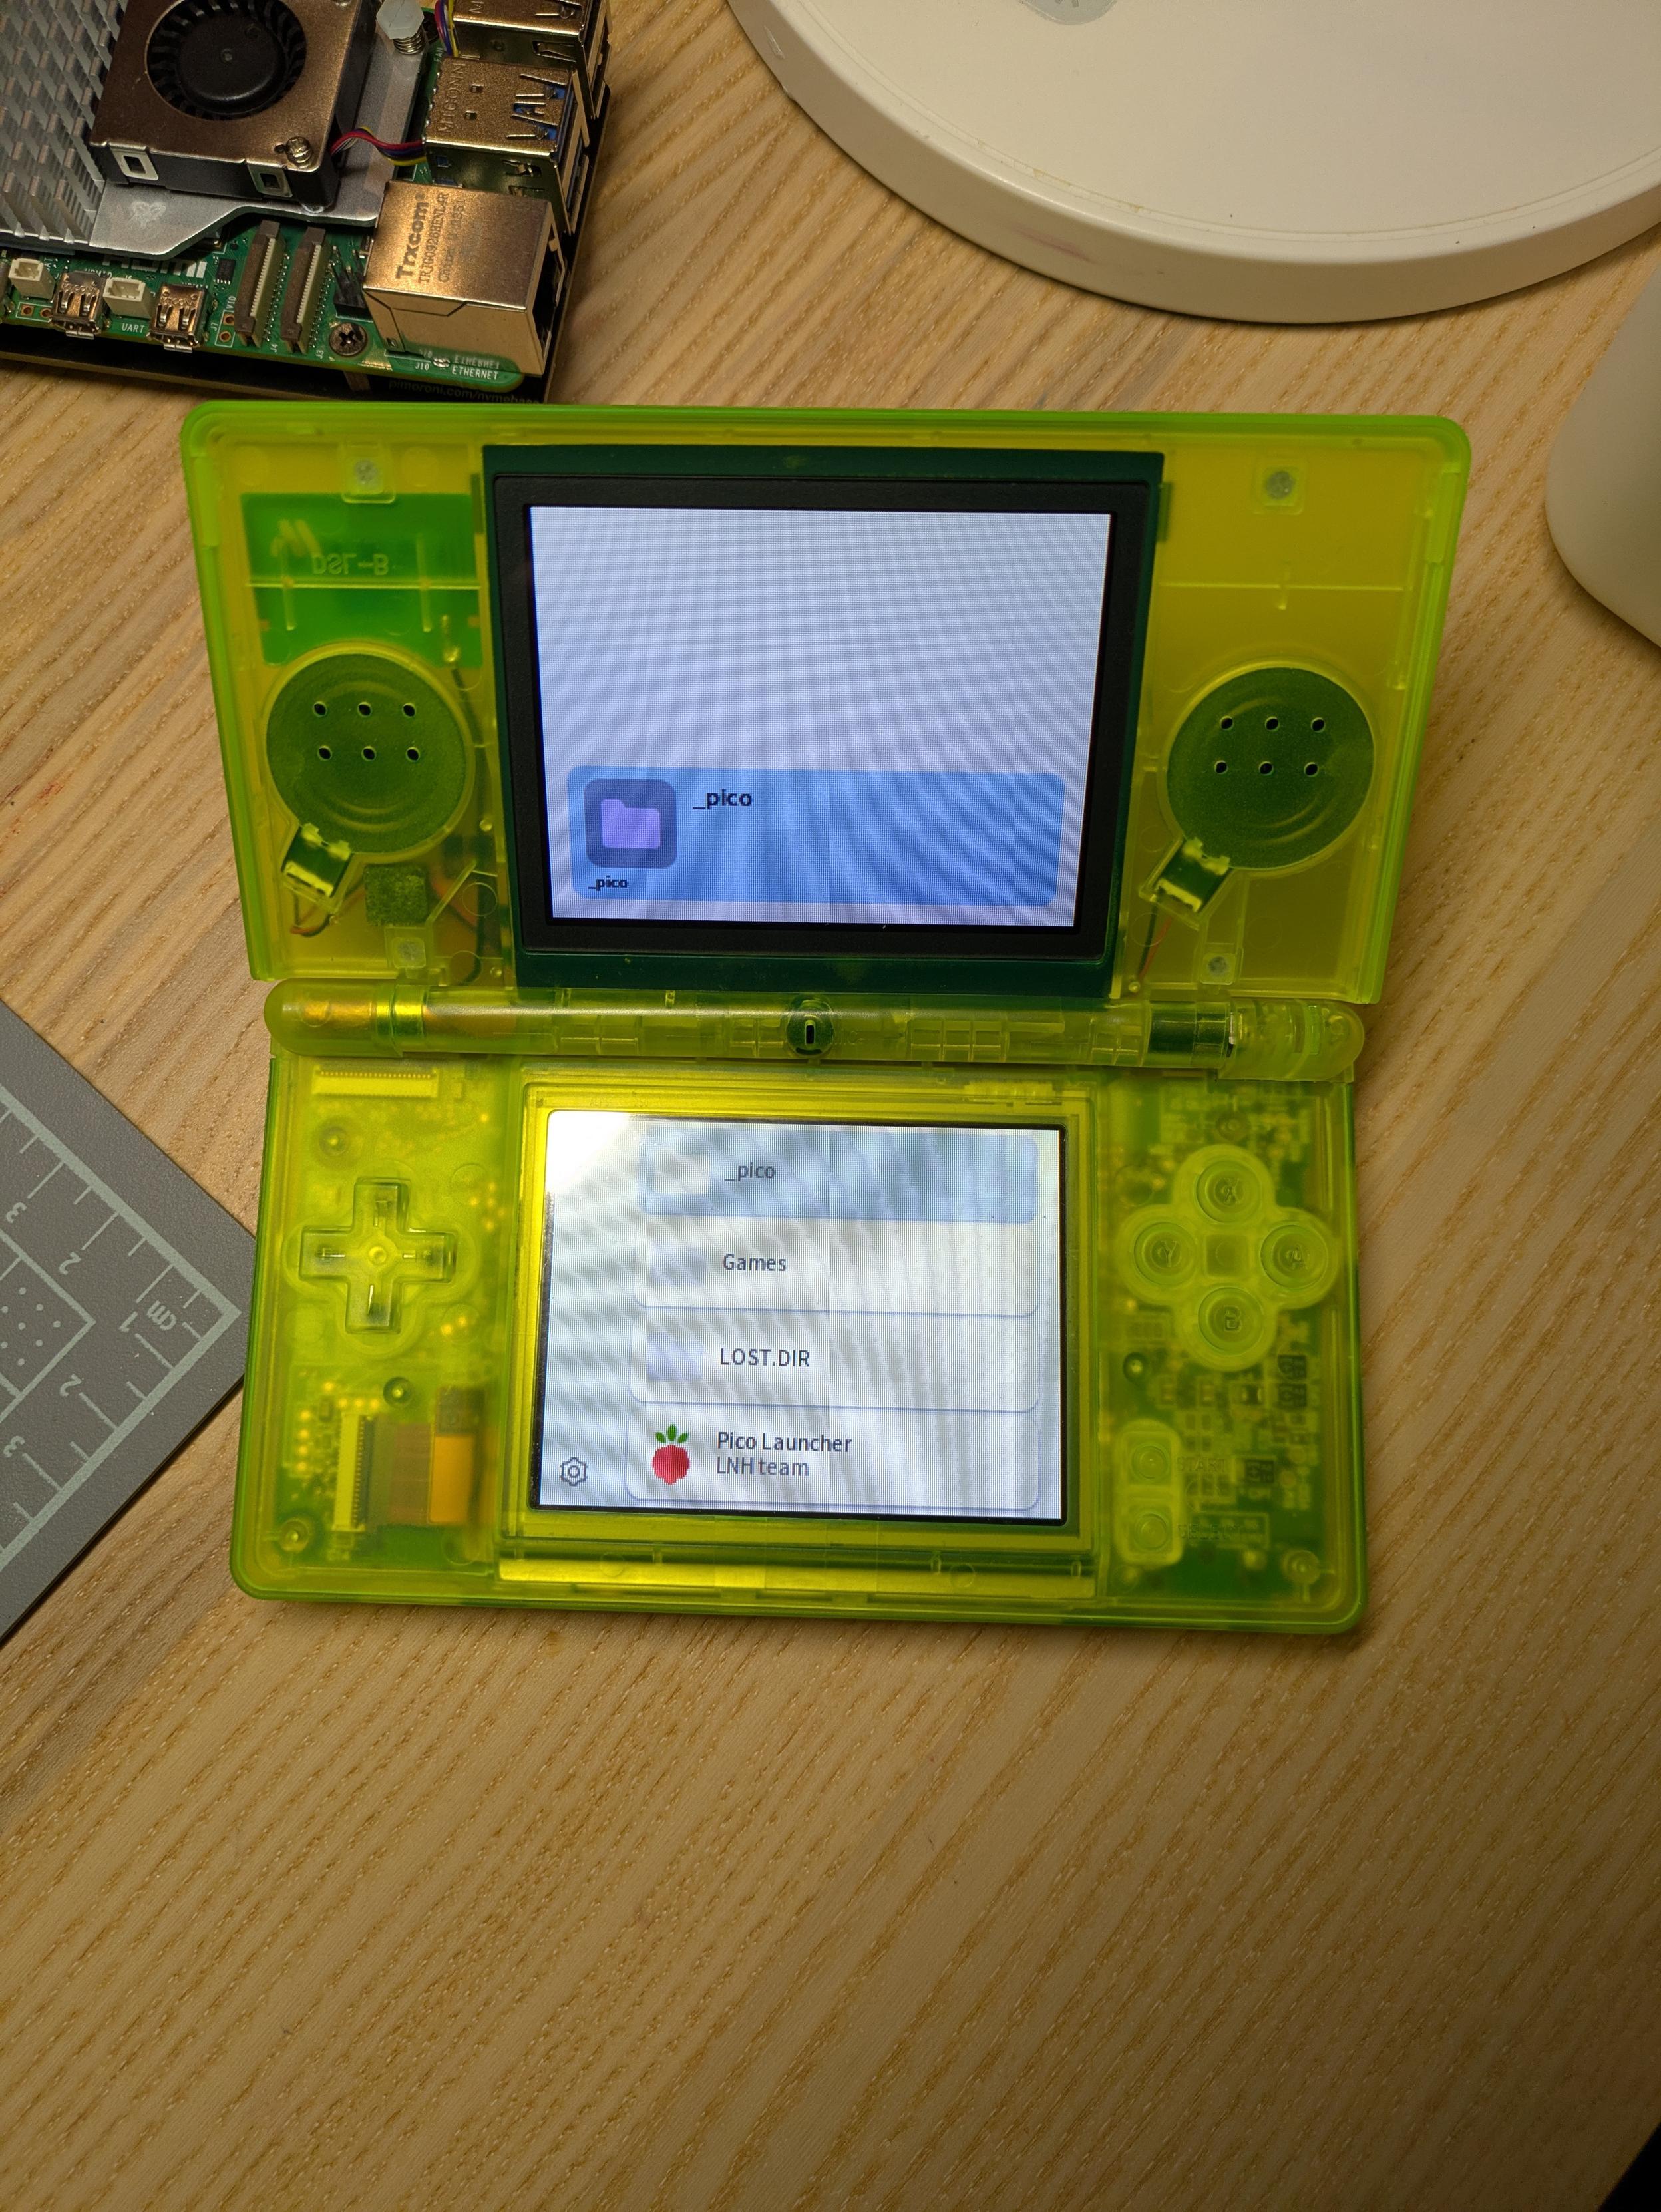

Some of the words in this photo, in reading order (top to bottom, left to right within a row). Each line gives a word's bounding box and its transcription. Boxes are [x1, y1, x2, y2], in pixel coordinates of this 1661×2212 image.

[122, 323, 145, 333] UART
[210, 322, 218, 331] J7
[270, 343, 278, 353] J4
[316, 350, 324, 359] J3
[415, 362, 429, 371] J10
[452, 365, 499, 380] ETHERNET
[692, 789, 753, 810] _pico
[588, 875, 628, 891] _pico
[724, 1162, 776, 1181] _pico
[6, 1202, 27, 1224] 3
[59, 1252, 82, 1275] 2
[723, 1253, 787, 1272] Games
[119, 1311, 138, 1332] 1
[146, 1300, 177, 1331] cm
[1224, 1305, 1242, 1332] B
[720, 1348, 810, 1367] LOST.DIR
[59, 1373, 83, 1397] 2
[3, 1435, 26, 1458] 3
[718, 1431, 757, 1449] Pico
[763, 1433, 852, 1452] Launcher
[717, 1456, 754, 1475] LNH
[759, 1457, 809, 1476] team
